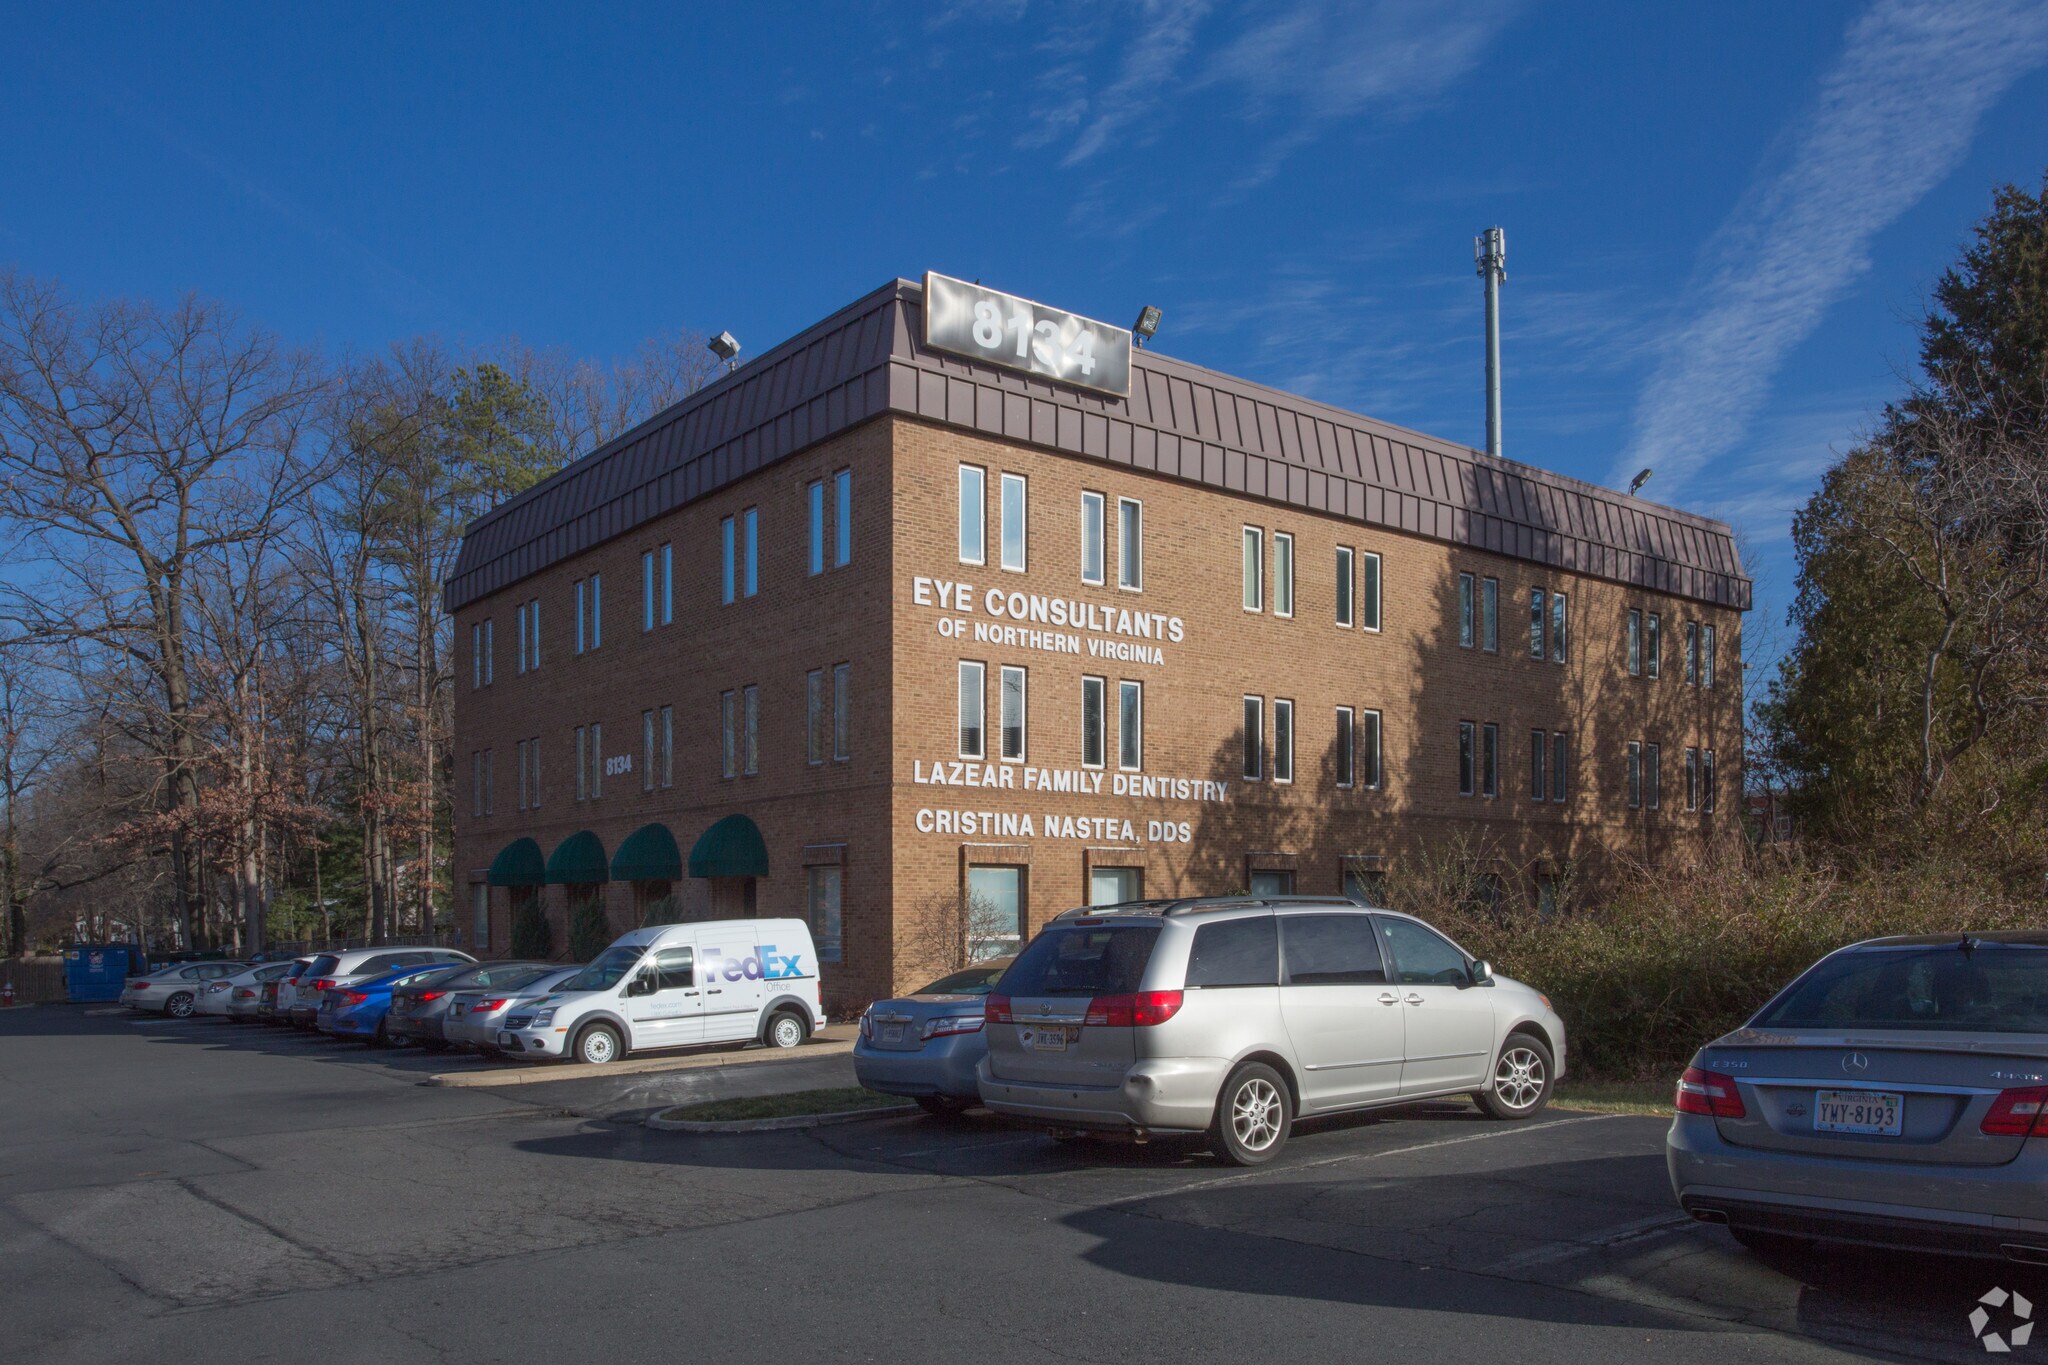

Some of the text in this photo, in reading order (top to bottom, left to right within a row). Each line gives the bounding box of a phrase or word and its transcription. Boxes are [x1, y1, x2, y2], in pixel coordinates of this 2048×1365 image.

[972, 301, 1095, 375] 8134
[913, 576, 1184, 642] EYE CONSULTANTS
[938, 617, 1164, 665] OF NORTHERN VIRGINIA
[606, 754, 632, 776] 8134
[914, 760, 1228, 801] LAZEAR FAMILY DENTISTRY
[916, 808, 1191, 843] CRISTINA NASTEA, DDS
[702, 945, 803, 982] FedEx
[766, 982, 791, 992] Office
[1821, 1103, 1894, 1126] YMY-8193
[1839, 1095, 1878, 1104] VIRGINIA
